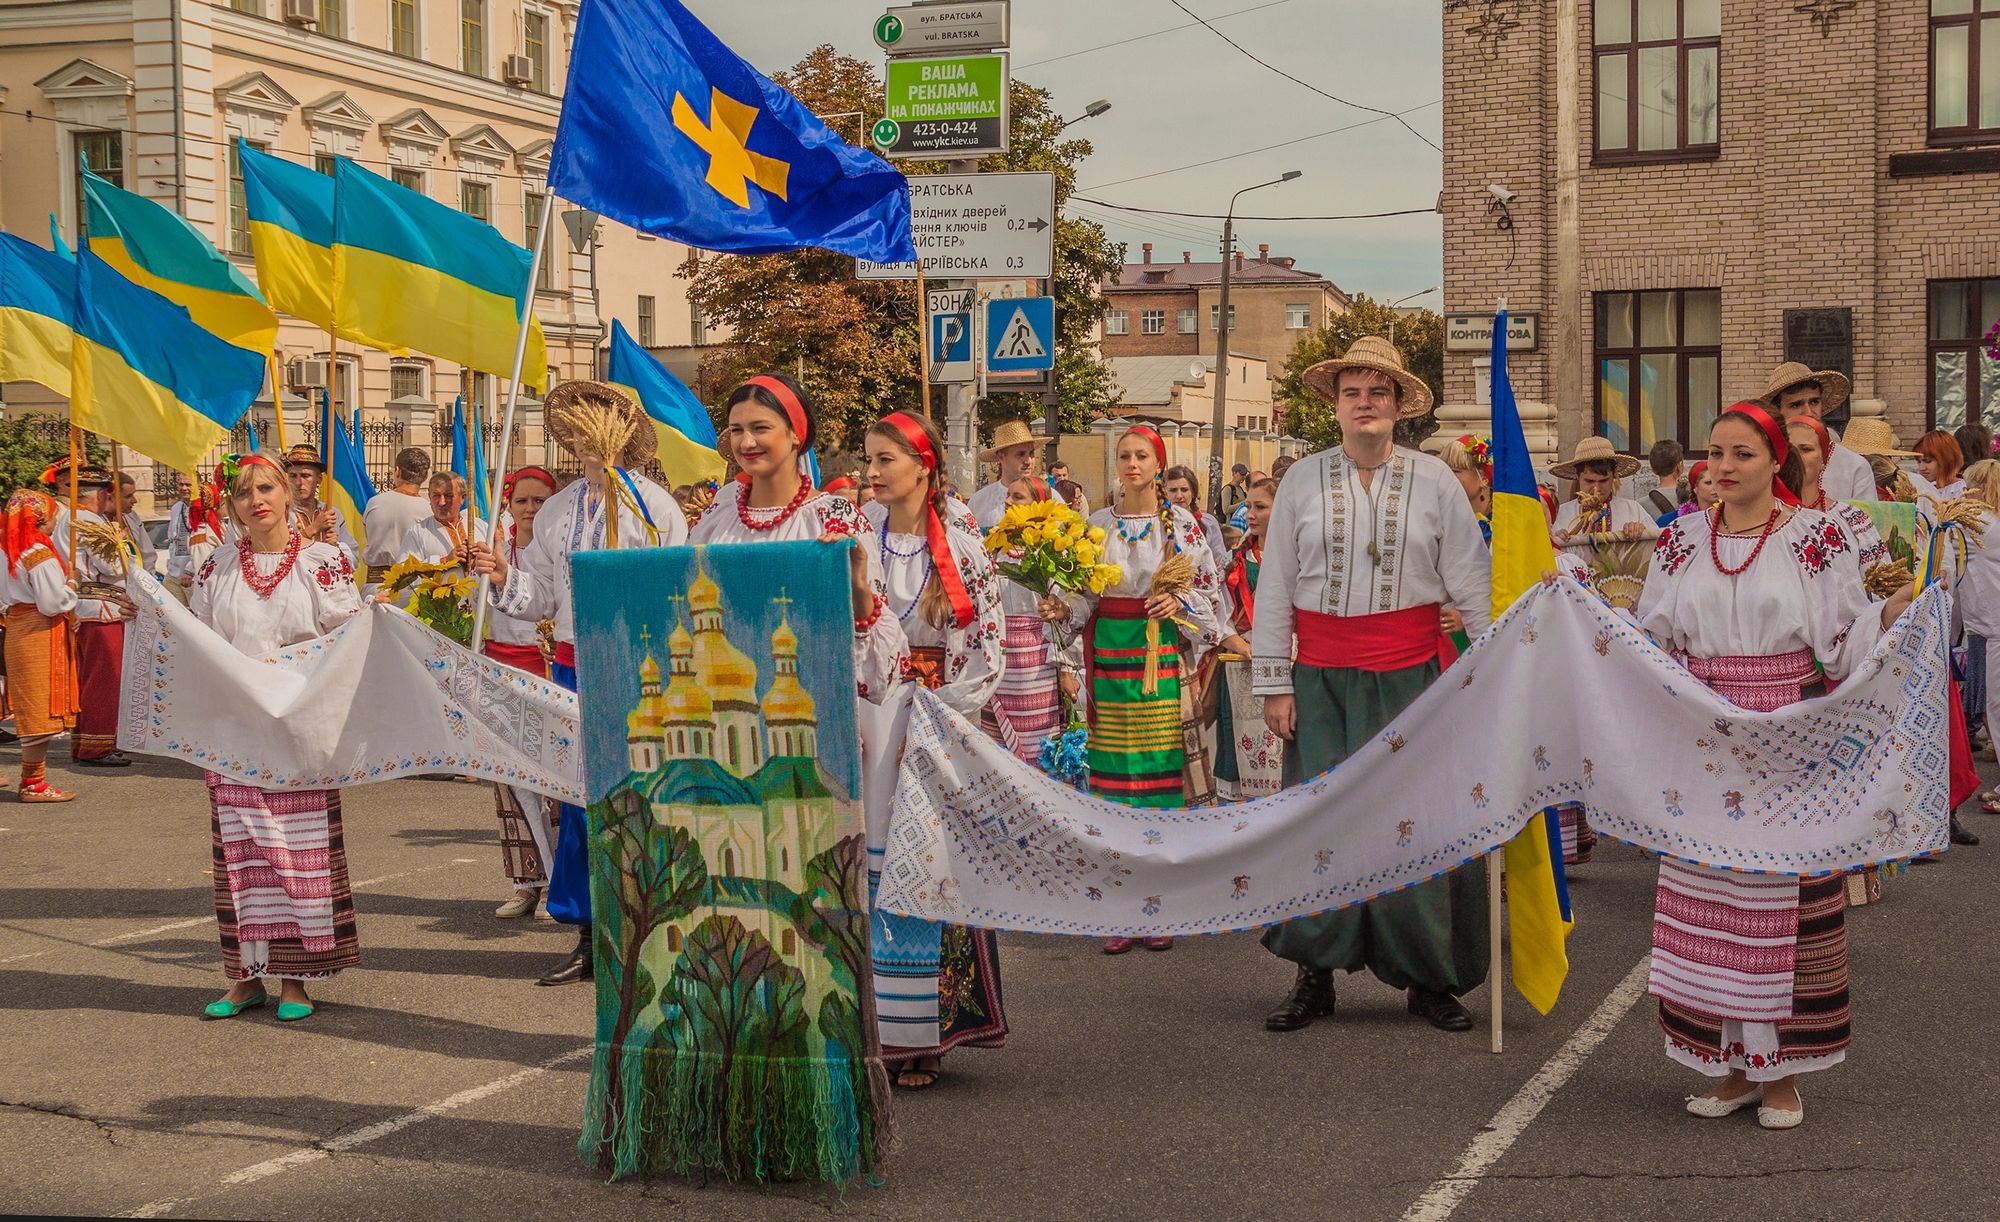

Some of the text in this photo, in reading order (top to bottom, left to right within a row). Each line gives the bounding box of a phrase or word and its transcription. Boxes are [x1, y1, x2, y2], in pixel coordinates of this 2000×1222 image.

[920, 11, 983, 23] вул. БРАТСЬКА
[941, 31, 980, 40] BRATSKA
[921, 64, 966, 82] ВАША
[908, 82, 979, 101] РЕКЛАМА
[891, 100, 996, 118] НА ПОКАЖЧИКАХ
[913, 122, 978, 136] 423-0-424
[912, 136, 979, 149] www.ykc.kiev.ua
[913, 204, 1007, 219] вхідних дверей
[945, 221, 988, 233] ключів
[1007, 218, 1025, 233] 0,2
[912, 233, 965, 248] АЙСТЕР»
[1006, 256, 1024, 271] 0,3
[1450, 329, 1531, 340] КОНТРАОВА
